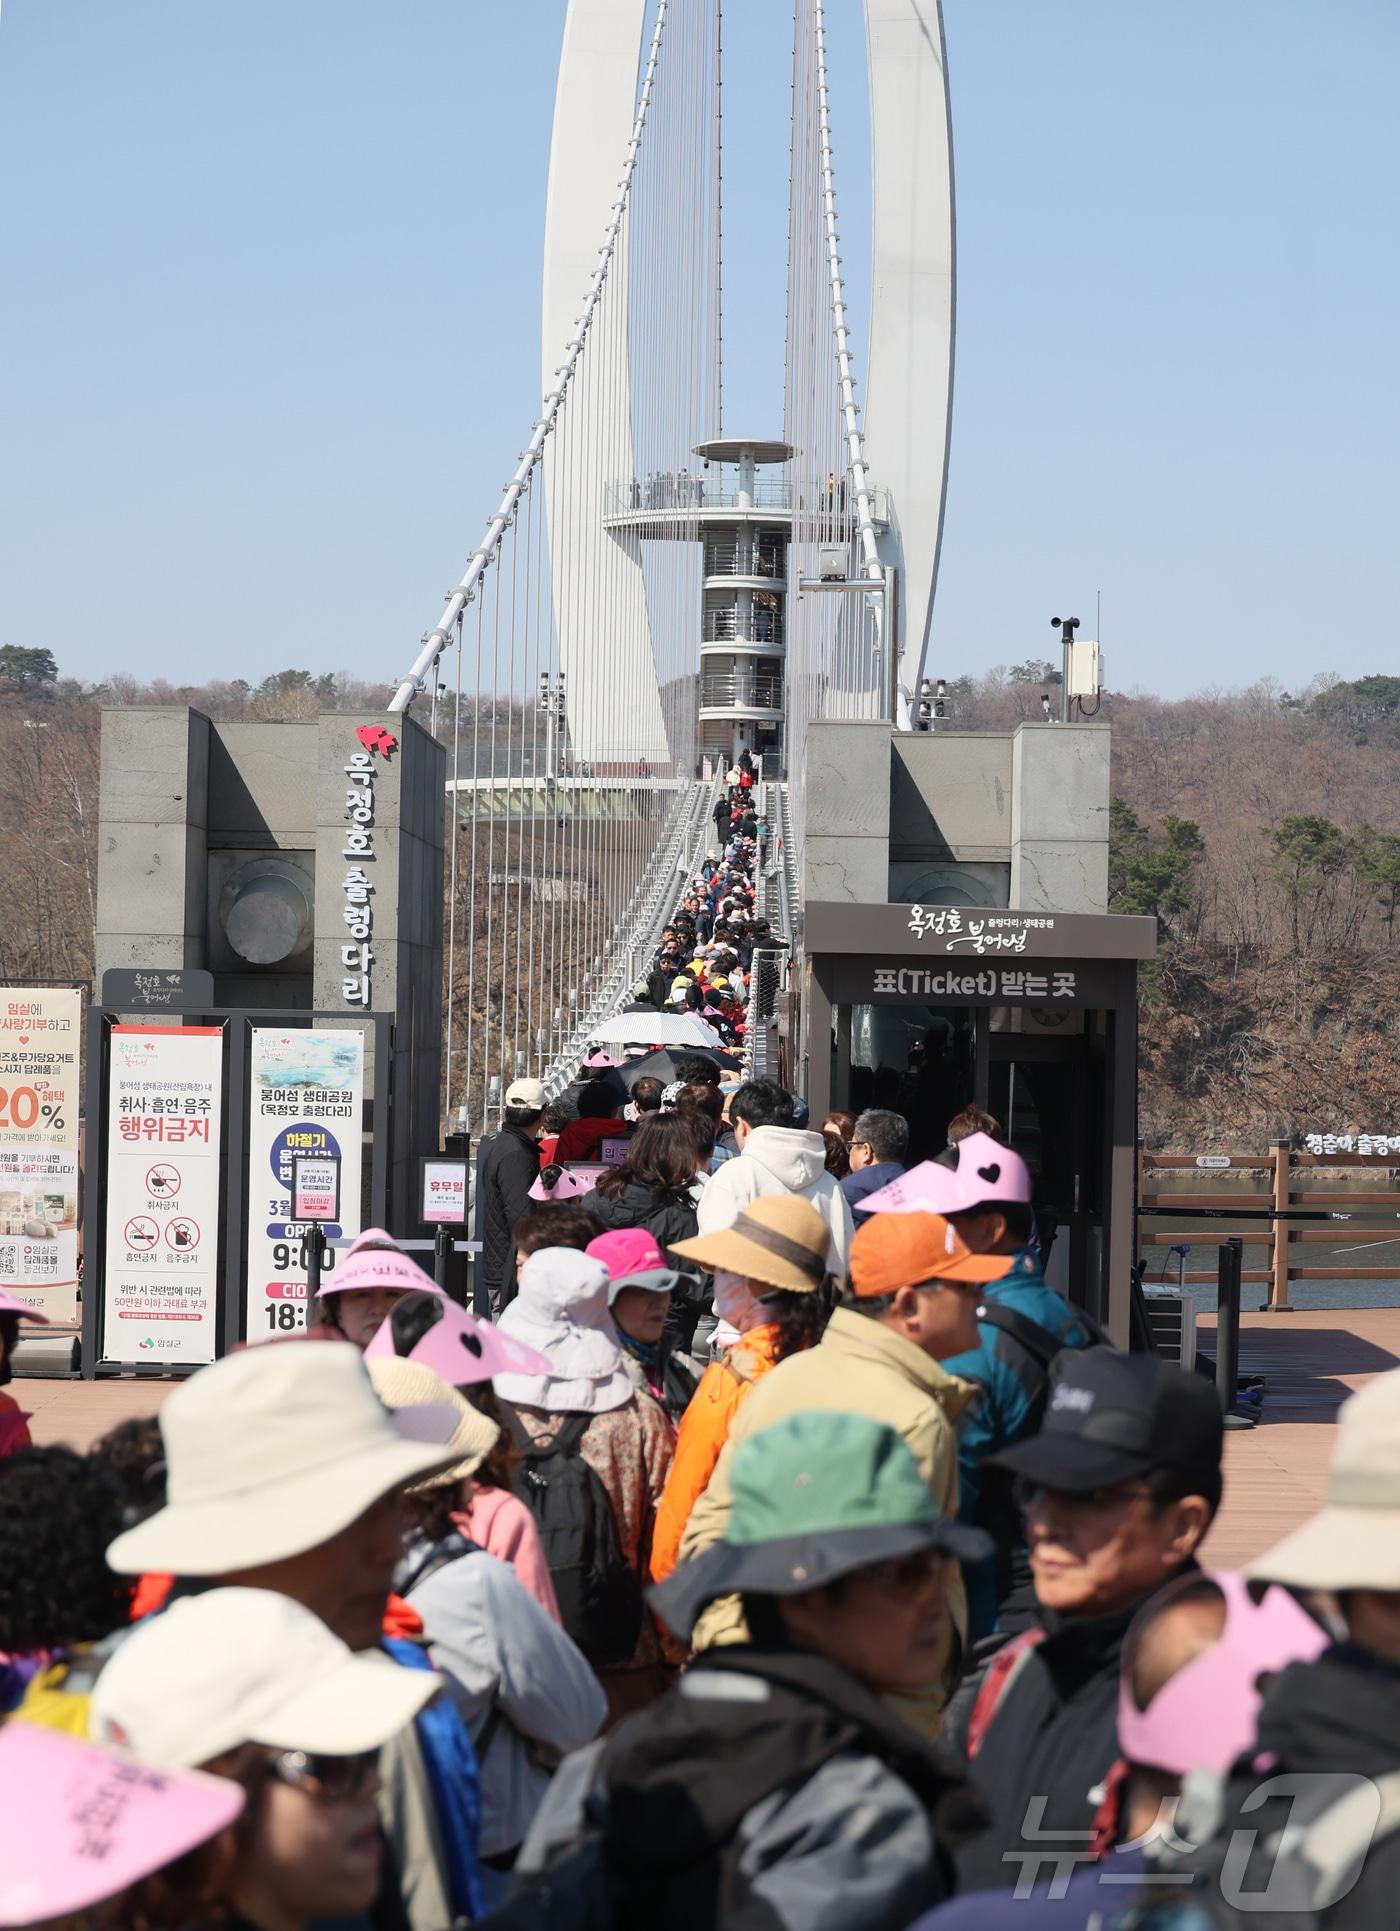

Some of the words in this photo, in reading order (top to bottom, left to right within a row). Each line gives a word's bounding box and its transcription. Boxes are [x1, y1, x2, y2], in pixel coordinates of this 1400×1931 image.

[342, 753, 375, 855] 옥정호
[908, 904, 963, 939] 옥정호
[988, 918, 1019, 928] 출렁다리
[1022, 919, 1054, 929] 생태공원
[341, 866, 374, 1005] 출렁다리
[946, 920, 1027, 954] 붕어섬
[873, 968, 996, 996] 표(Ticket)
[1001, 971, 1048, 997] 받는
[1052, 972, 1076, 997] 곳
[8, 1003, 42, 1016] 임실에
[0, 1018, 71, 1031] 사랑기부하고
[0, 1052, 74, 1063] 즈&무가당요거트
[120, 1081, 141, 1090] 붕어섬
[204, 1083, 212, 1091] 내
[42, 1090, 65, 1102] 혜택
[261, 1089, 299, 1102] 붕어섬
[303, 1090, 353, 1103] 생태공원
[261, 1103, 299, 1116] (옥정호
[303, 1105, 352, 1117] 출렁다리)
[119, 1116, 209, 1143] 행위금지
[286, 1133, 326, 1148] 하절기
[301, 1175, 333, 1183] 운영시간
[430, 1181, 463, 1192] 휴무일
[147, 1200, 179, 1210] 취사금지
[126, 1252, 157, 1262] 흡연금지
[166, 1253, 198, 1263] 음주금지
[120, 1284, 136, 1295] 위반
[139, 1285, 147, 1295] 시
[150, 1285, 183, 1296] 관련법에
[185, 1286, 202, 1296] 따라
[114, 1297, 142, 1307] 50만원
[144, 1298, 161, 1308] 이하
[163, 1298, 188, 1308] 과태료
[190, 1299, 207, 1309] 부과
